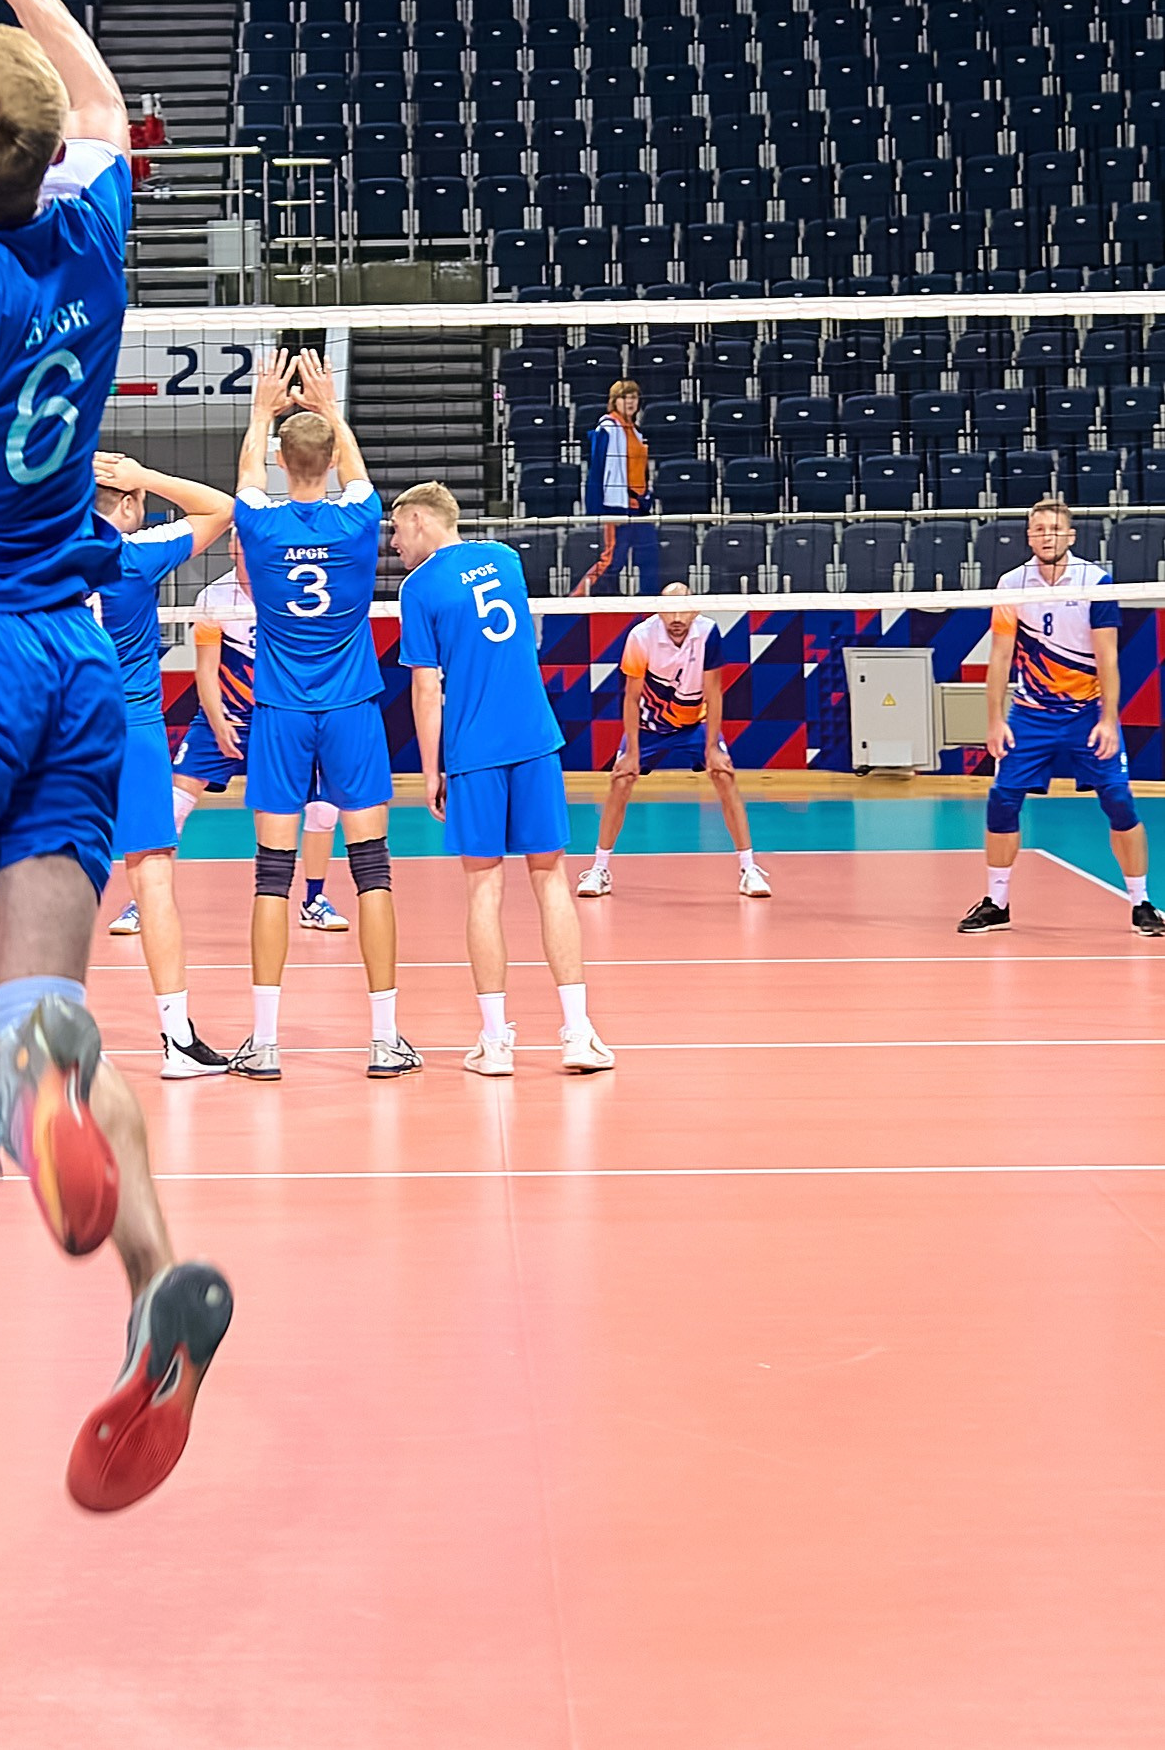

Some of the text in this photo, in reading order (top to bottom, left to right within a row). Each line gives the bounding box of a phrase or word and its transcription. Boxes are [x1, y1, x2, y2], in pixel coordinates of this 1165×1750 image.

[166, 345, 252, 395] 2.2
[5, 349, 84, 484] 6
[286, 563, 331, 618] 3
[472, 578, 517, 643] 5
[1043, 612, 1053, 636] 8
